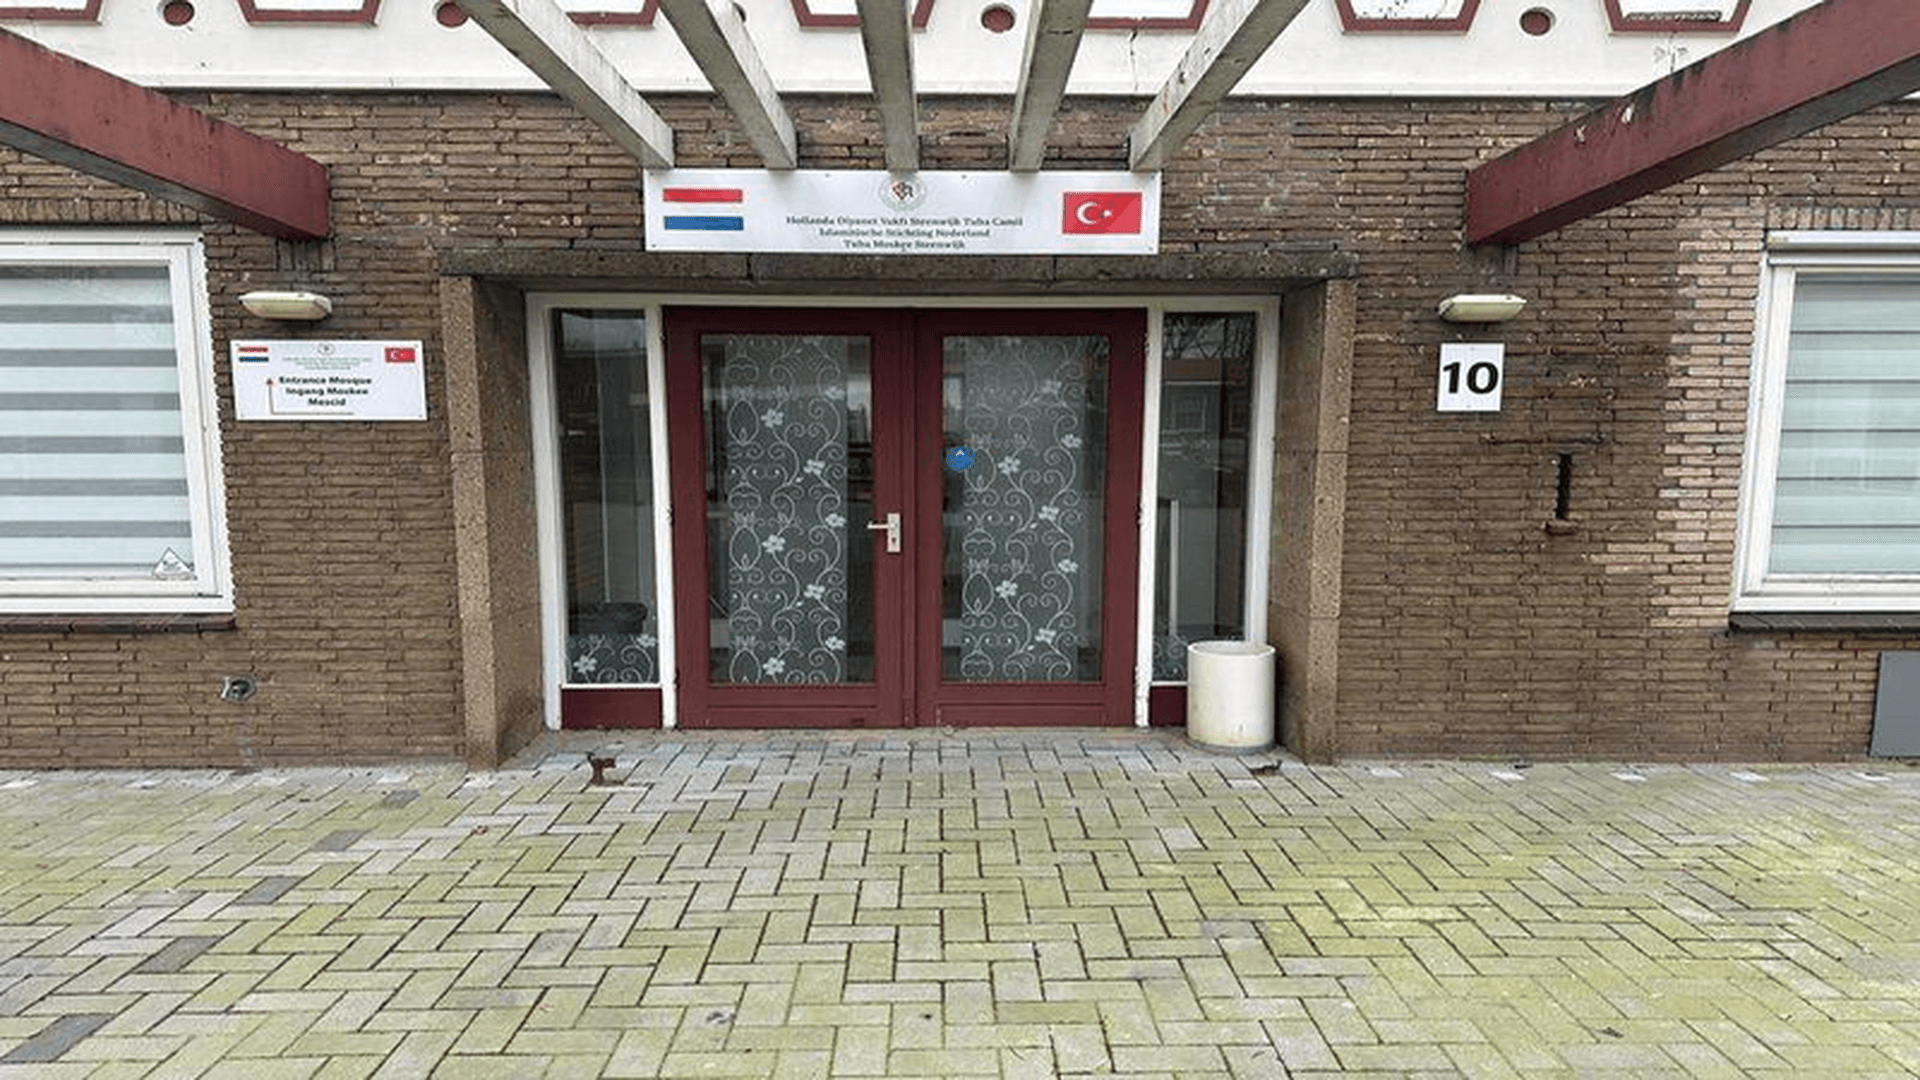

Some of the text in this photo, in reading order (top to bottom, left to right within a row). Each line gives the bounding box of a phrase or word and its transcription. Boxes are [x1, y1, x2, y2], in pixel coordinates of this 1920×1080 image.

[962, 217, 990, 226] Tuba
[278, 376, 372, 387] Entrance Mosque
[1443, 361, 1500, 395] 10
[285, 387, 369, 397] Ingang Moskee
[307, 397, 347, 407] Mescid
